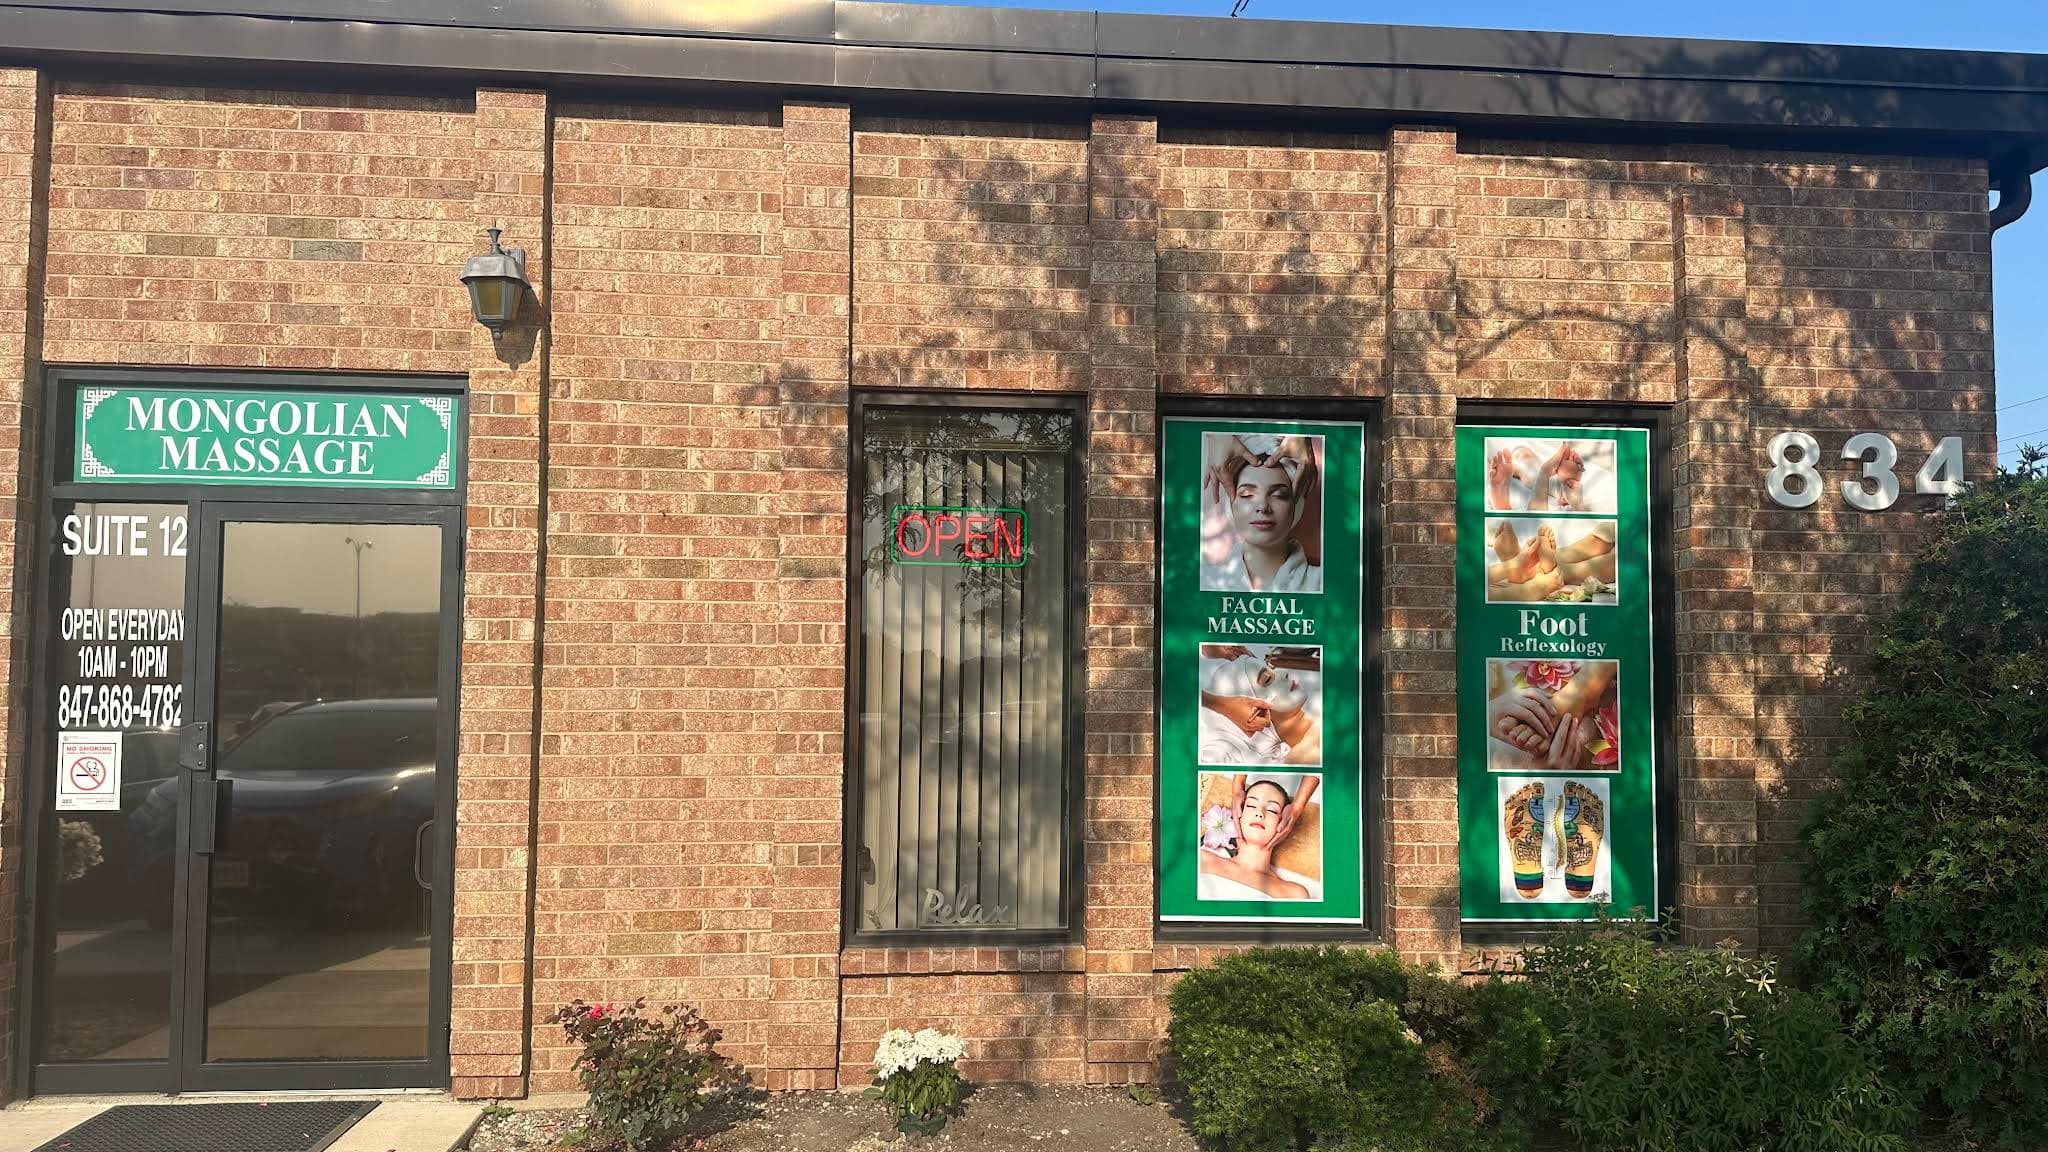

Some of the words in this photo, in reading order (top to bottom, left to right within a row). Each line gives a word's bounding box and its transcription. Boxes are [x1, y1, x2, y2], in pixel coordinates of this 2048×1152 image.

[125, 396, 411, 439] MONGOLIAN
[158, 435, 375, 475] MASSAGE
[1765, 431, 1974, 511] 834
[62, 514, 149, 557] SUITE
[159, 515, 188, 557] 12
[894, 513, 1022, 559] OPEN
[61, 607, 104, 641] OPEN
[108, 608, 185, 641] EVERYDAY
[1220, 596, 1303, 615] FACIAL
[1518, 609, 1588, 637] Foot
[1207, 616, 1315, 636] MASSAGE
[78, 645, 117, 678] 10AM
[130, 645, 168, 678] 10PM
[1500, 637, 1607, 656] Reflexology
[58, 684, 182, 729] 847-868-4782
[922, 883, 1009, 924] Relax
